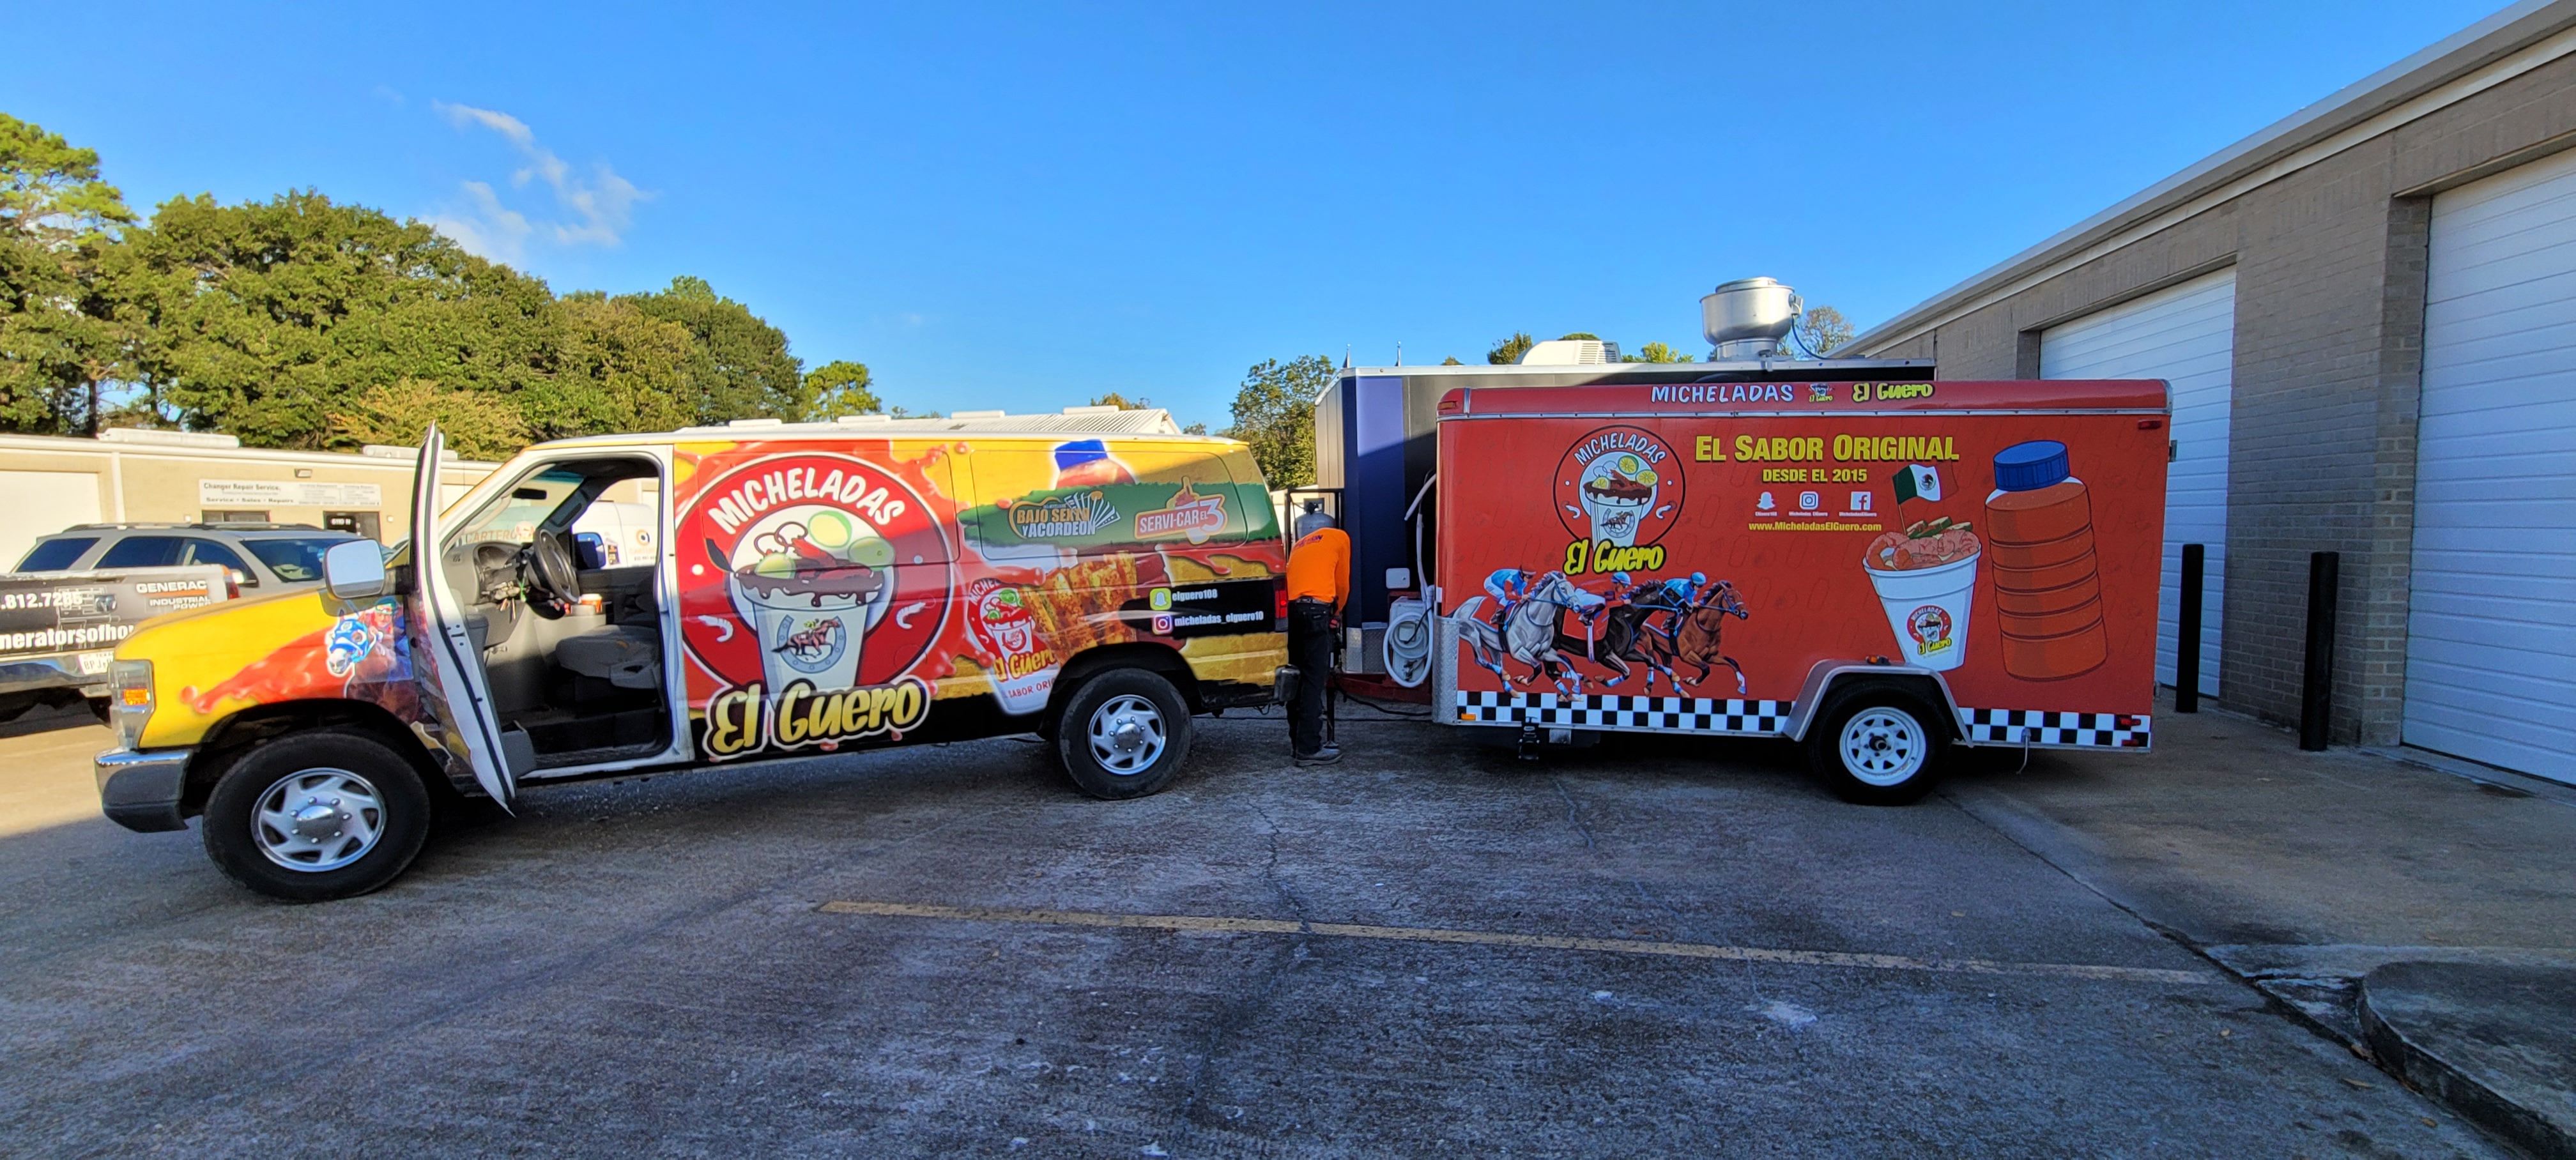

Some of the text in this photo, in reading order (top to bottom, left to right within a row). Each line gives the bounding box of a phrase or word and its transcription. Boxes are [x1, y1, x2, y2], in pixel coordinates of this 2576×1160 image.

[1650, 385, 1794, 403] MICHELADAS
[1853, 383, 1935, 402] El Guero
[1574, 432, 1667, 466] MICHELADAS
[1696, 434, 1960, 461] EL SABOR ORIGINAL
[1762, 468, 1867, 483] DESDE EL 2015
[708, 466, 906, 535] MICHELADAS
[1016, 508, 1090, 524] BAJO SEXTO
[1139, 509, 1199, 533] SERVI-CAR
[1199, 498, 1225, 532] 3
[1748, 521, 1882, 531] www.MicheladasElGuero.com
[1564, 538, 1664, 576] El Guero
[136, 580, 207, 593] GENERAC
[150, 596, 210, 607] INDUSTRIAL
[1174, 610, 1264, 627] micheladas_elguero10
[712, 680, 922, 754] El Guero
